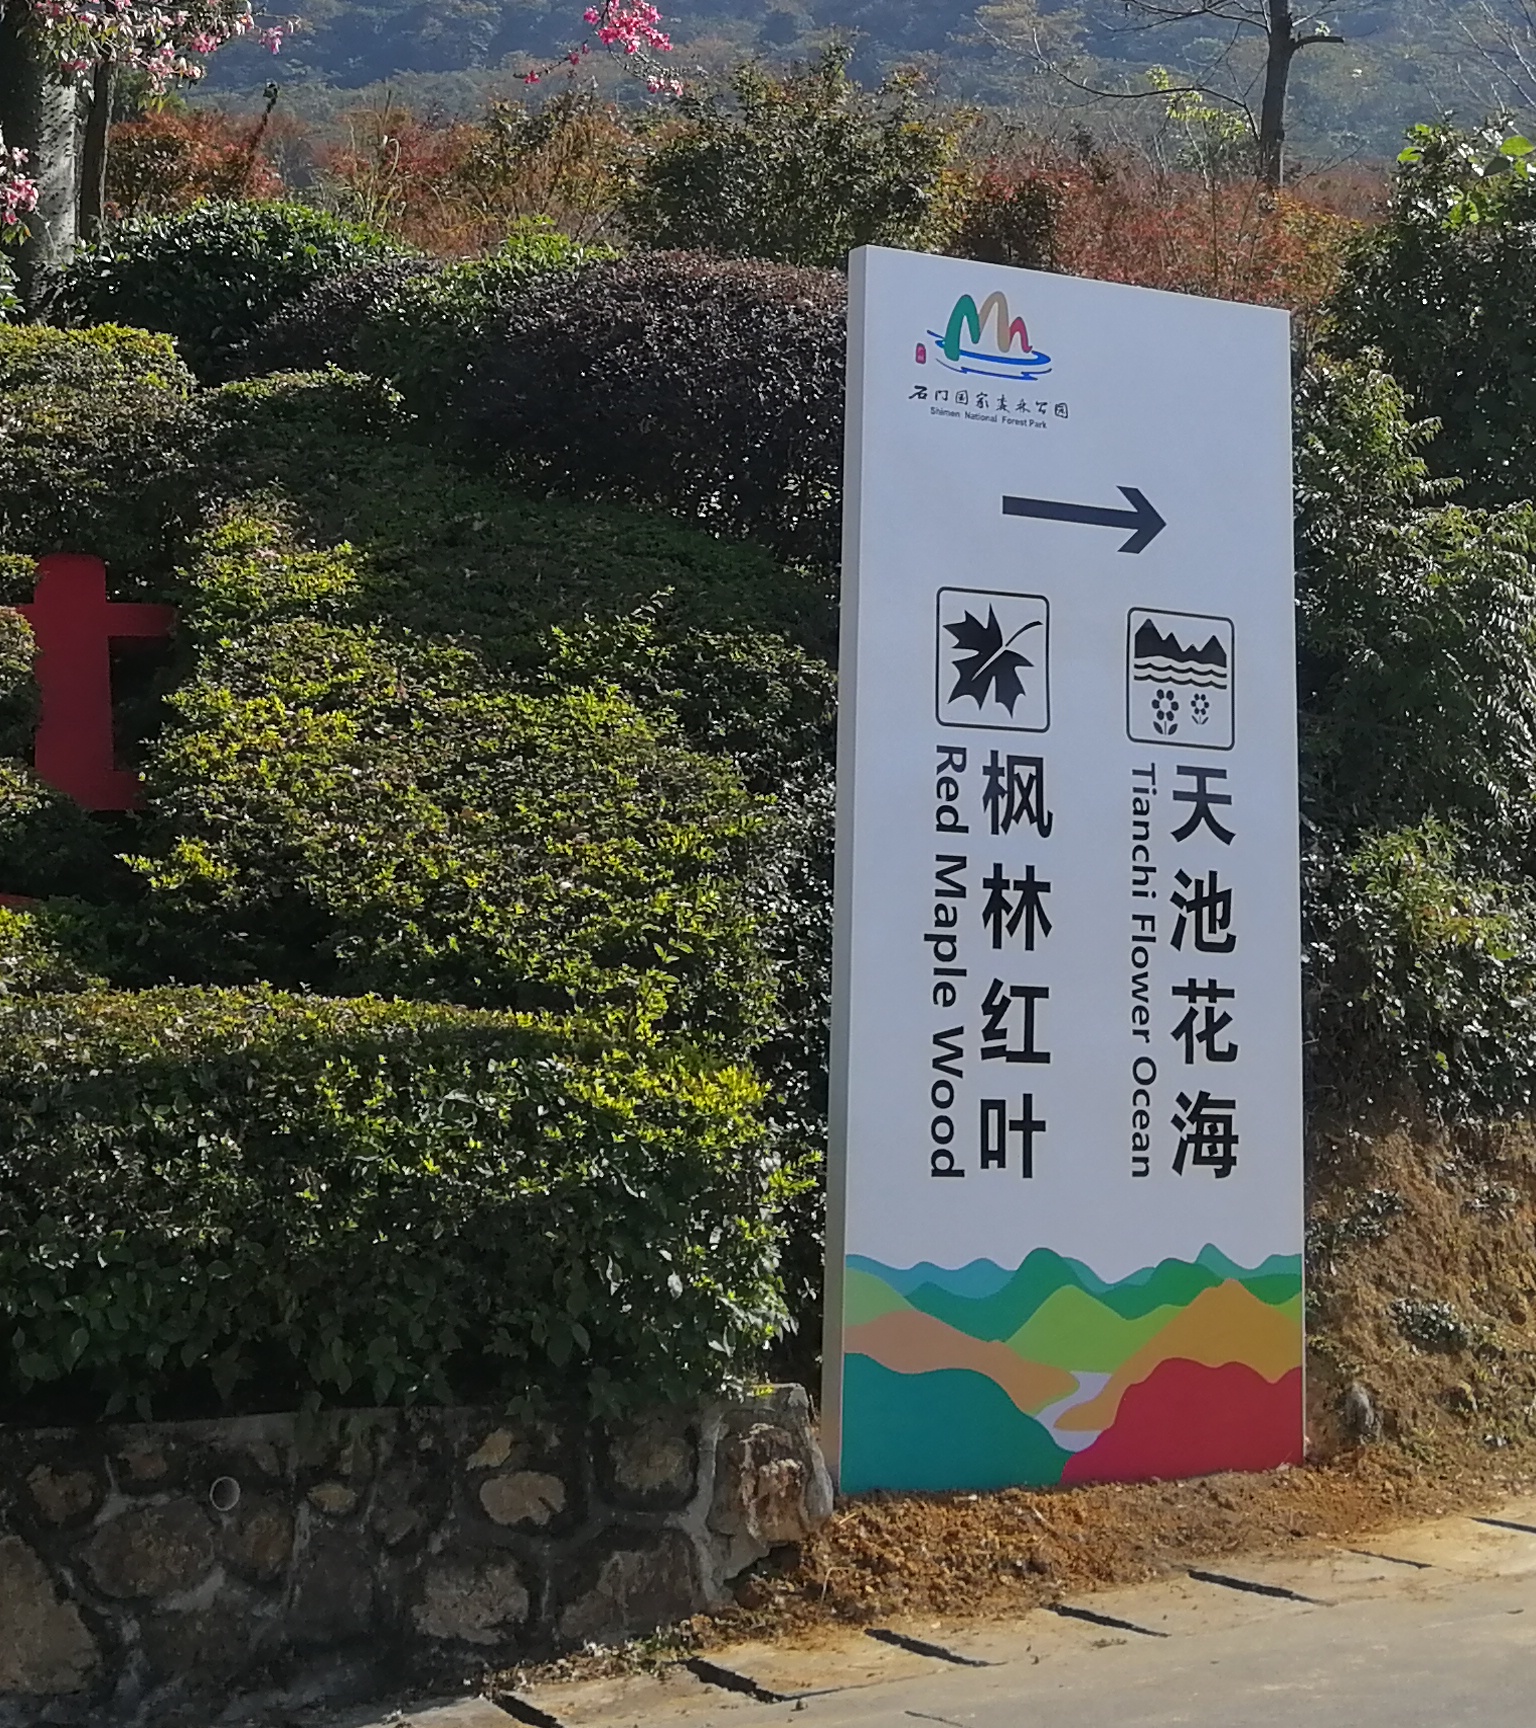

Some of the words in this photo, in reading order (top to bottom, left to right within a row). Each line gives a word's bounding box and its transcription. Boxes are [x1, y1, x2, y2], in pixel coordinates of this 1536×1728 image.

[908, 385, 1069, 419] 石门国家森林公园
[930, 406, 961, 418] Shimen
[964, 411, 998, 424] National
[1002, 416, 1028, 428] Forest
[1029, 419, 1048, 430] Park
[935, 744, 969, 834] Red
[1130, 762, 1157, 899] Tianchi
[924, 853, 968, 1008] Maple
[980, 749, 1054, 1179] 枫林红叶
[1130, 912, 1157, 1044] Flower
[1170, 764, 1240, 1179] 天池花海
[930, 1024, 966, 1178] Wood
[1130, 1056, 1158, 1178] Ocean
